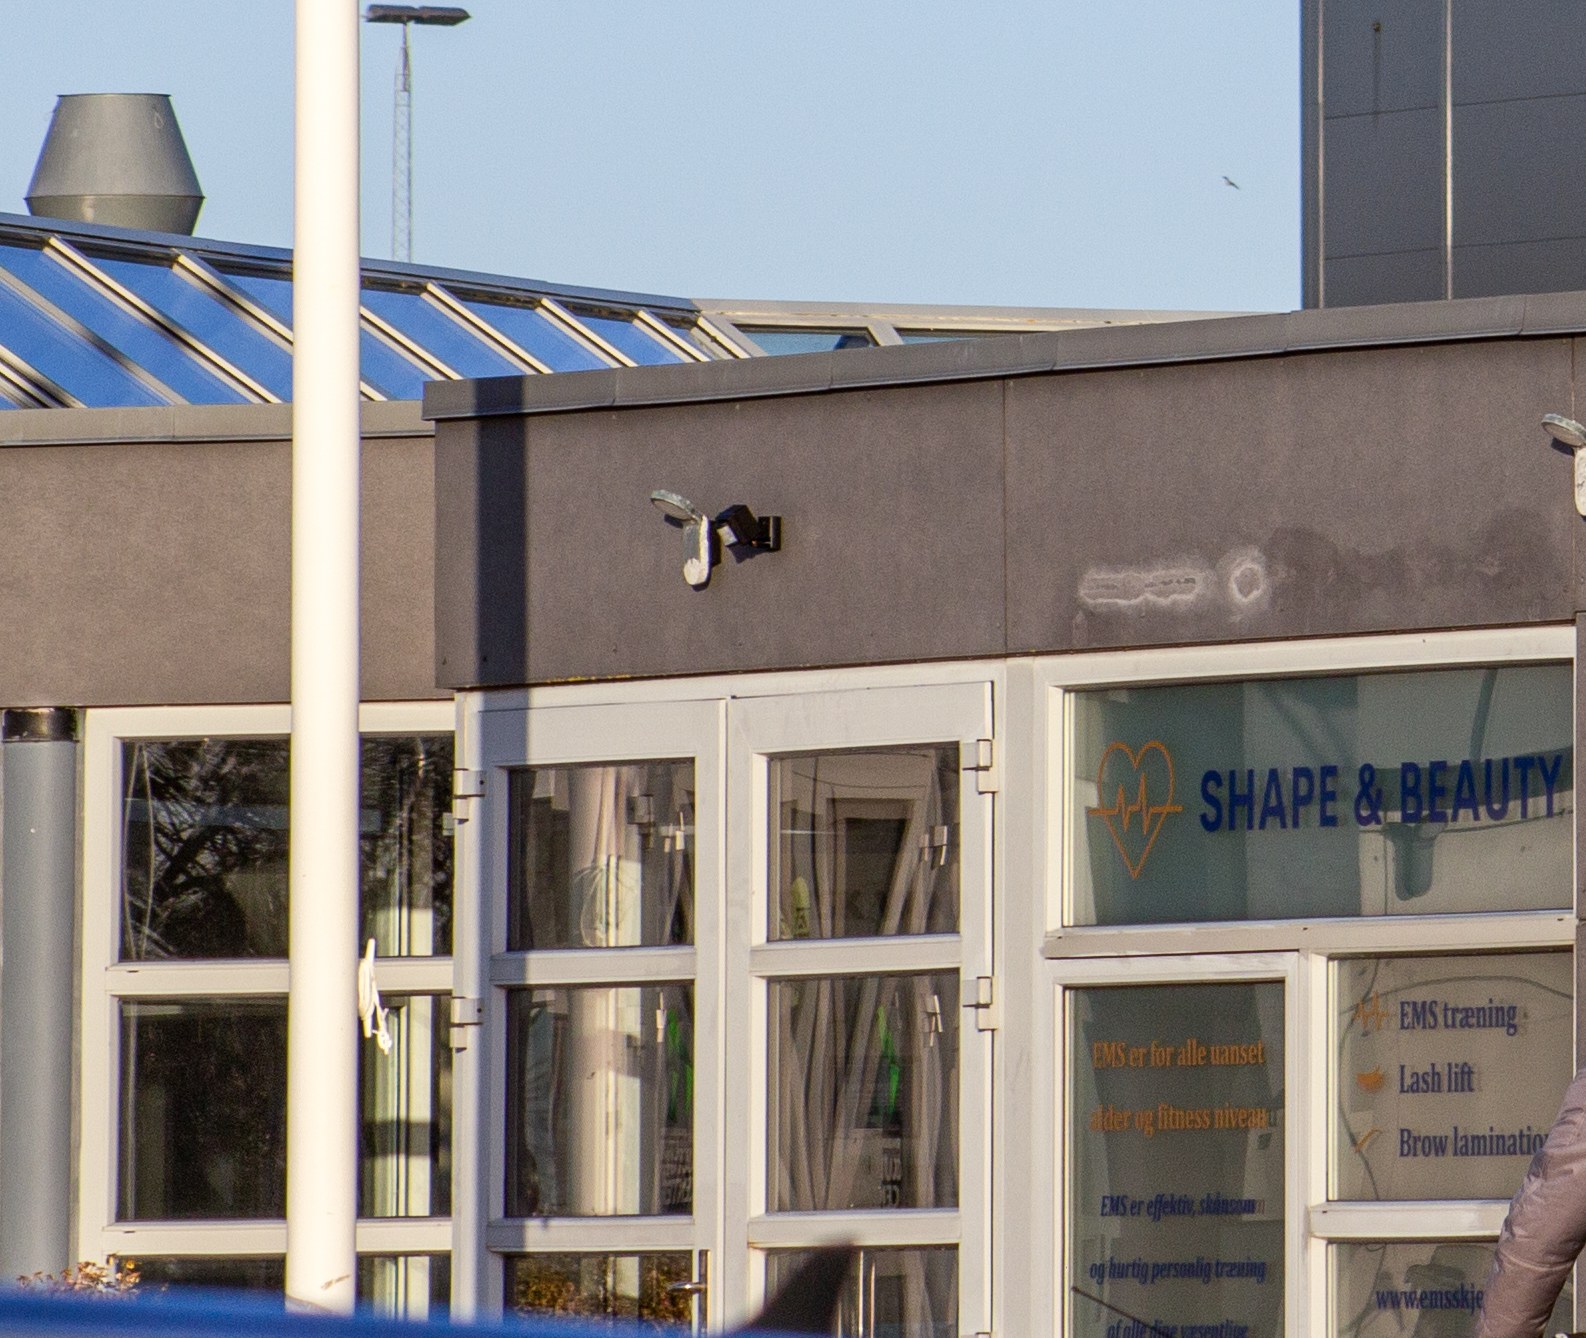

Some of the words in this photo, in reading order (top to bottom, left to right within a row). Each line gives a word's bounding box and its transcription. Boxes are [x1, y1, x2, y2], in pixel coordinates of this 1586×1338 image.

[1200, 764, 1337, 832] SHAPE
[1354, 763, 1382, 826] &
[1402, 754, 1563, 823] BEAUTY
[1400, 1001, 1438, 1030] EMS
[1443, 999, 1517, 1036] træning
[1093, 1042, 1126, 1068] EMS
[1130, 1046, 1147, 1067] er
[1151, 1040, 1174, 1066] for
[1177, 1037, 1207, 1065] alle
[1210, 1039, 1264, 1065] uanset
[1399, 1064, 1442, 1094] Lash
[1447, 1062, 1475, 1093] lift
[1090, 1104, 1131, 1131] alder
[1135, 1110, 1154, 1138] og
[1158, 1102, 1211, 1129] fitness
[1214, 1101, 1267, 1128] niveau
[1399, 1128, 1447, 1157] Brow
[1101, 1195, 1127, 1216] EMS
[1130, 1198, 1145, 1216] er
[1200, 1192, 1256, 1215] skånsom
[1089, 1263, 1105, 1285] og
[1108, 1256, 1149, 1285] hurtig
[1151, 1257, 1211, 1284] personlig
[1215, 1257, 1266, 1283] træning
[1375, 1281, 1485, 1315] www.emsskje
